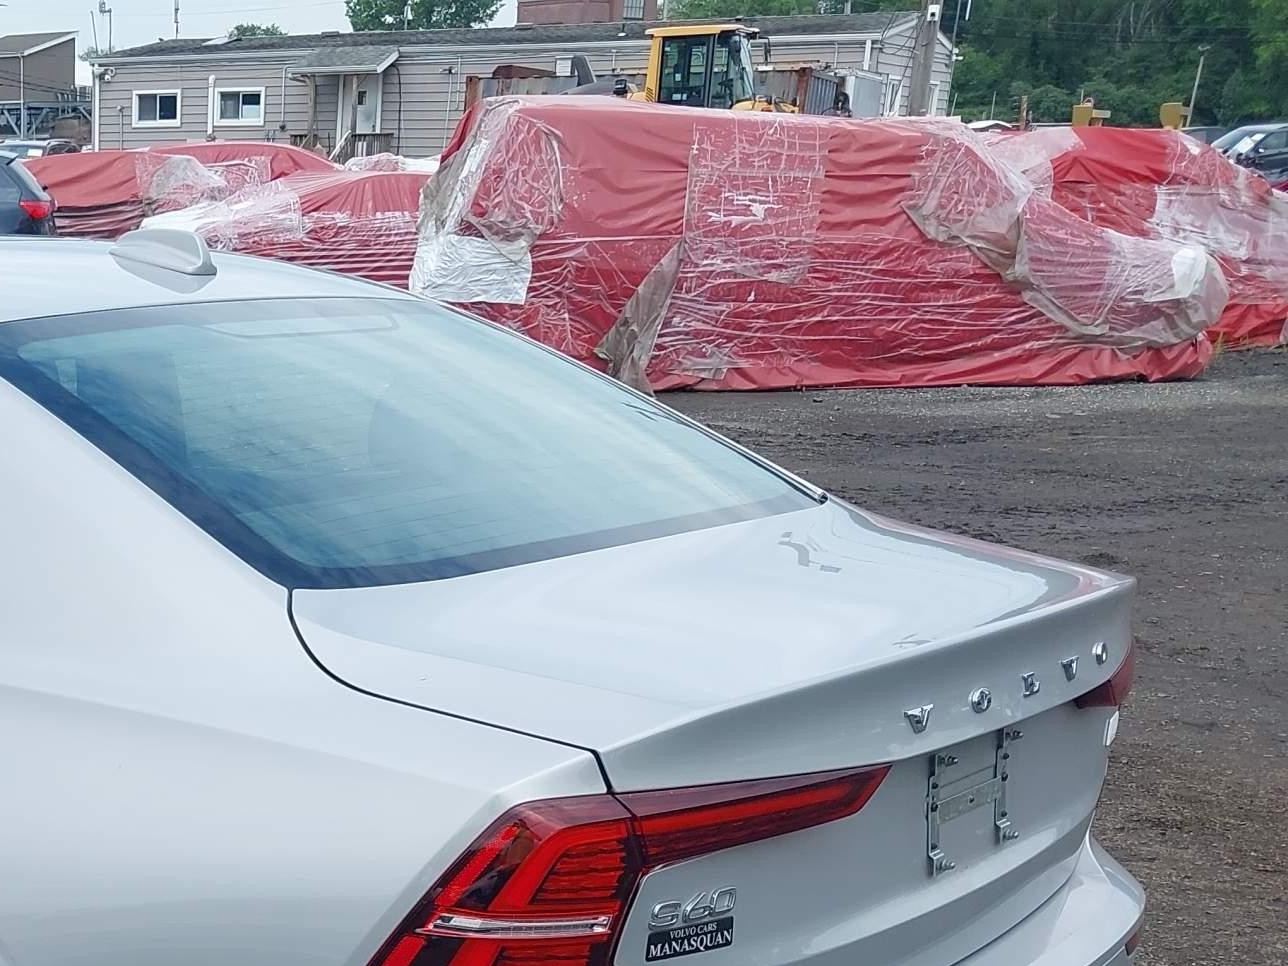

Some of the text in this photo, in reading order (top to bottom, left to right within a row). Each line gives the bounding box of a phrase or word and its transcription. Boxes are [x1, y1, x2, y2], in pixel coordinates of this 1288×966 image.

[902, 641, 1108, 734] VOLVO
[648, 886, 737, 932] S60
[647, 928, 732, 958] MANASQUAN
[669, 921, 718, 940] VOLVO CARS
